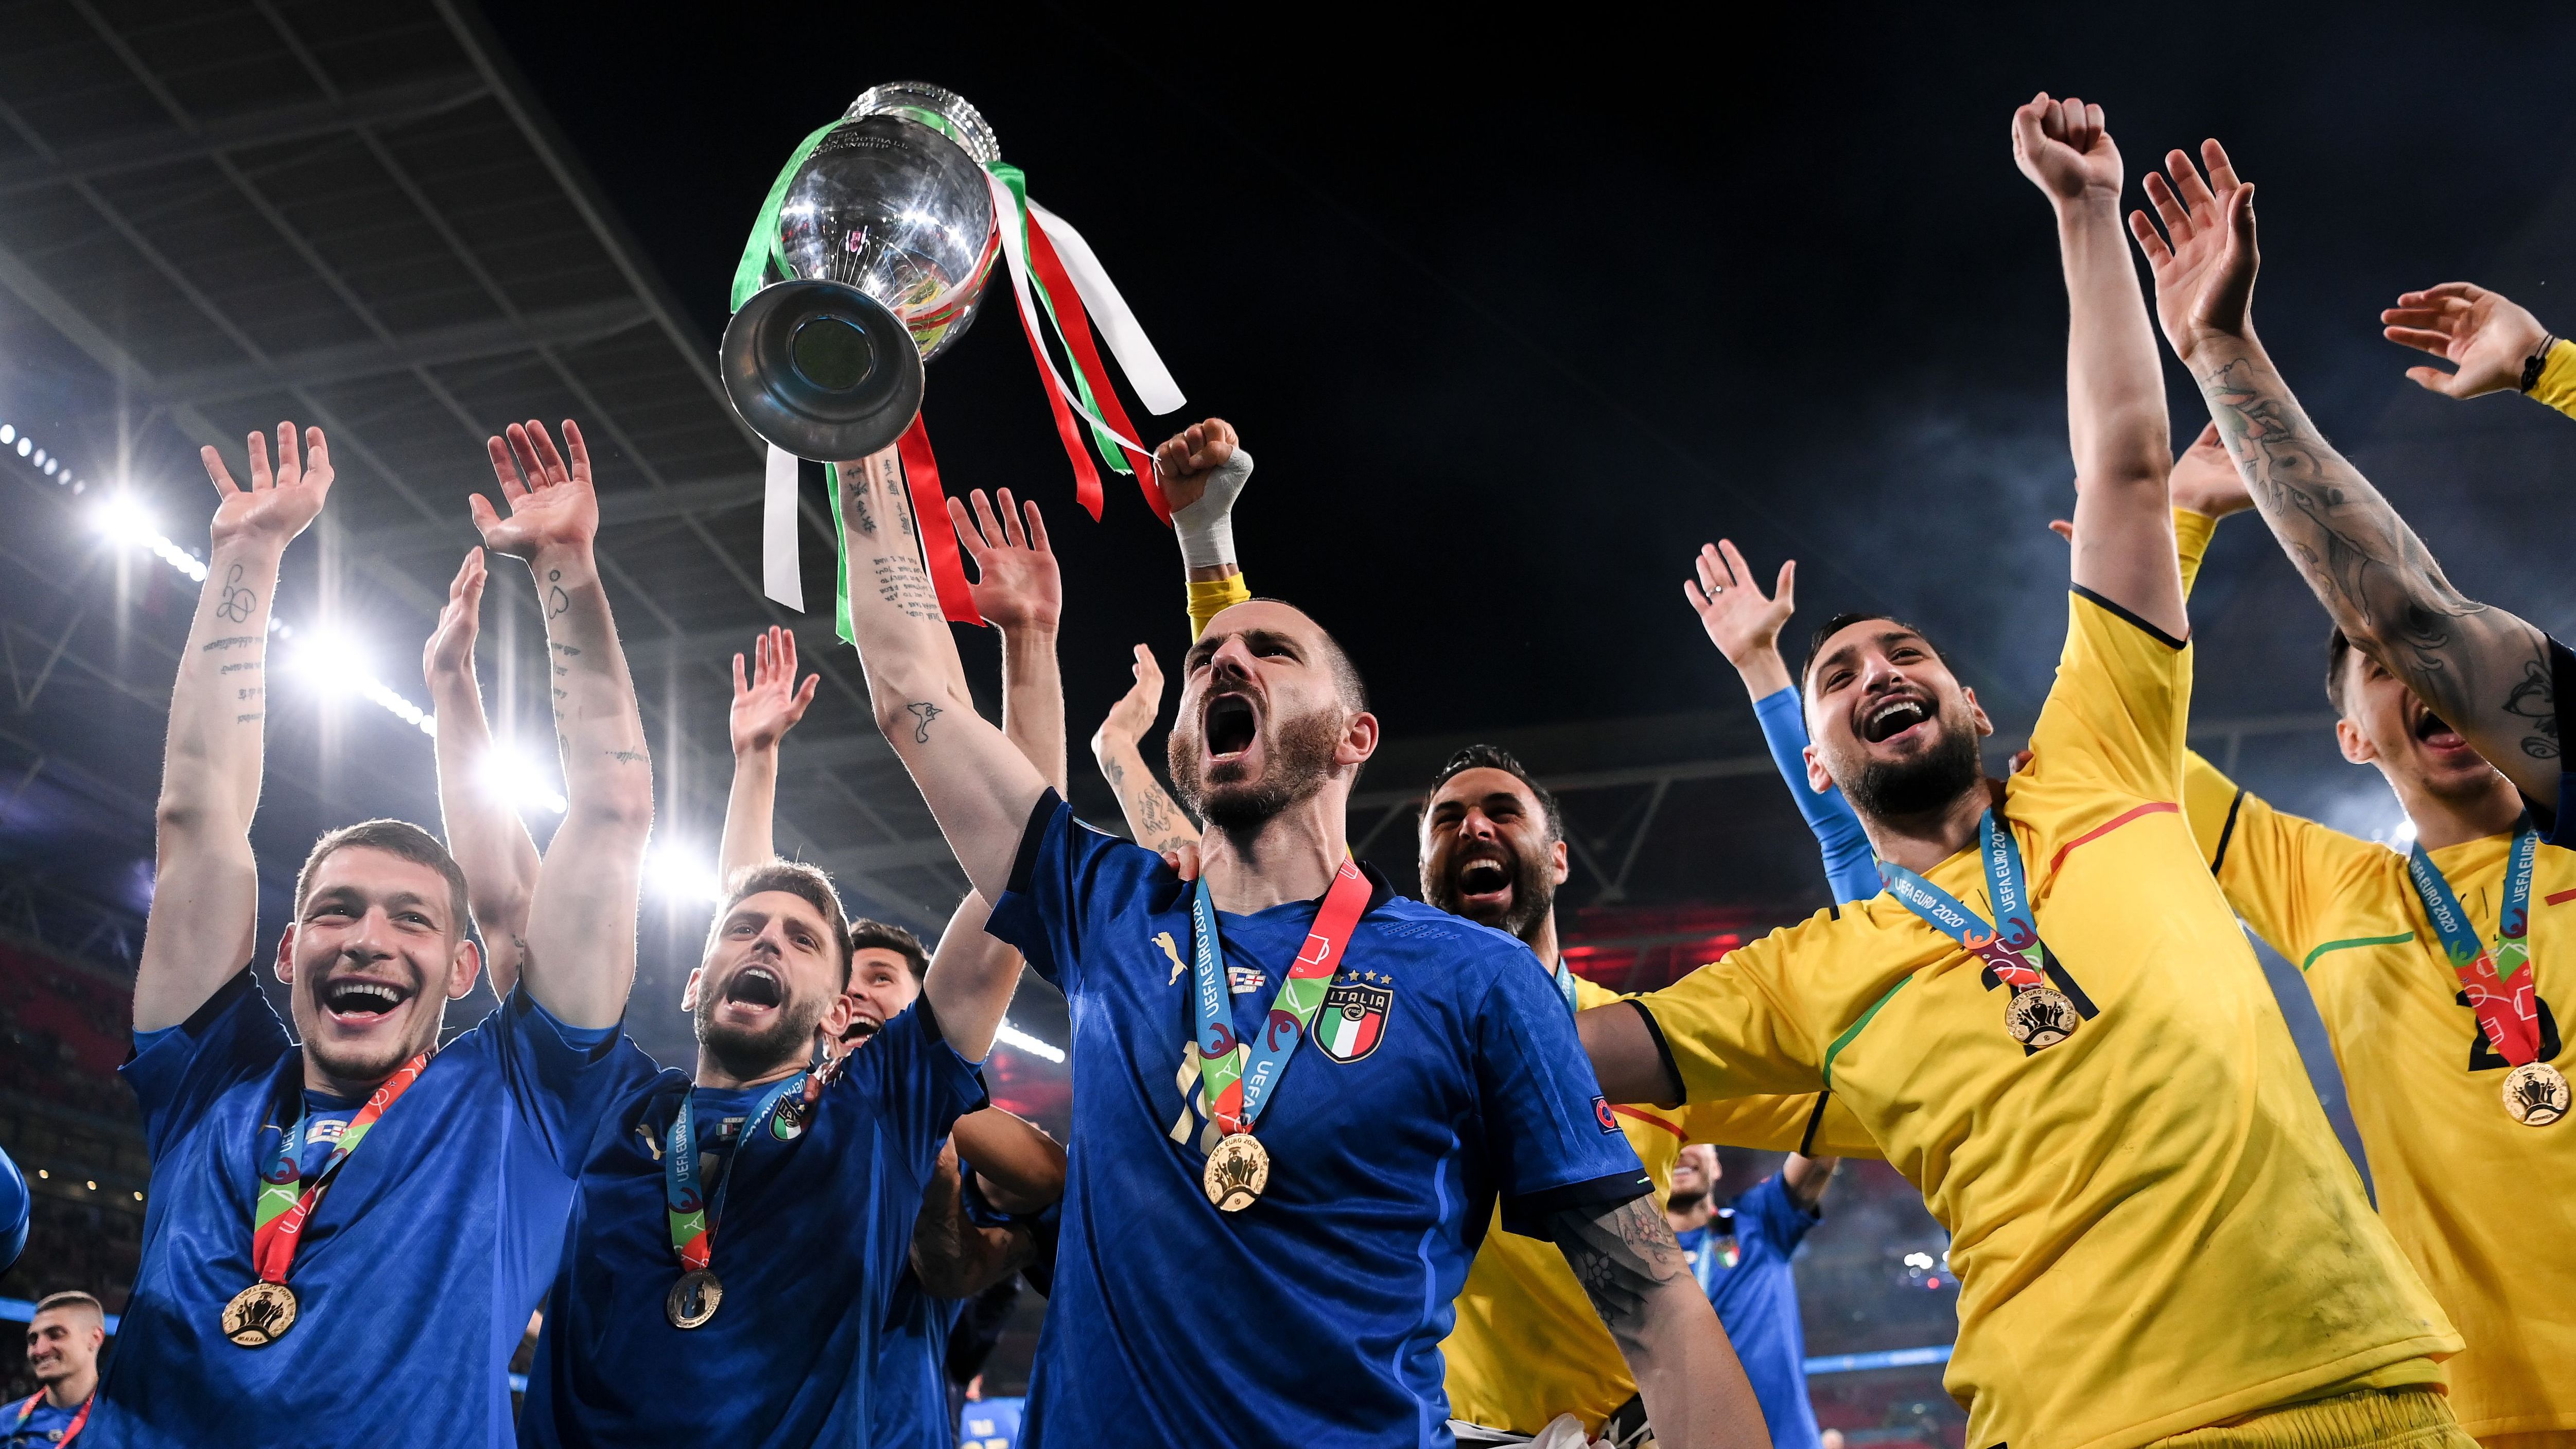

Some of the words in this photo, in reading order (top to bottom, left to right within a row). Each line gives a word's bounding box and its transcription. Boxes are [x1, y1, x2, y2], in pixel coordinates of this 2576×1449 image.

[844, 136, 908, 149] FOOTBALL
[1993, 849, 2010, 878] EURO
[2518, 836, 2537, 869] EURO
[1998, 876, 2016, 913] UEFA
[2512, 868, 2532, 903] UEFA
[1895, 877, 1914, 899] UEFA
[1912, 889, 1937, 909] EURO
[1931, 904, 1964, 927] 2020
[2420, 876, 2442, 906] EURO
[2433, 904, 2459, 933] 2020
[1193, 899, 1207, 938] 2020
[1197, 934, 1213, 976] EURO
[1202, 971, 1219, 1018] UEFA
[1330, 991, 1385, 1007] ITALIA
[2011, 997, 2024, 1009] UEFA
[2045, 990, 2061, 999] 2020
[1243, 1060, 1274, 1108] UEFA
[2517, 1066, 2535, 1074] EURO
[2537, 1066, 2553, 1074] 2020
[675, 1124, 687, 1153] EURO
[1210, 1146, 1224, 1162] UEFA
[1225, 1138, 1242, 1147] EURO
[1244, 1138, 1259, 1150] 2020
[676, 1151, 689, 1182] UEFA
[238, 1287, 257, 1299] UEFA
[278, 1288, 291, 1301] 2020
